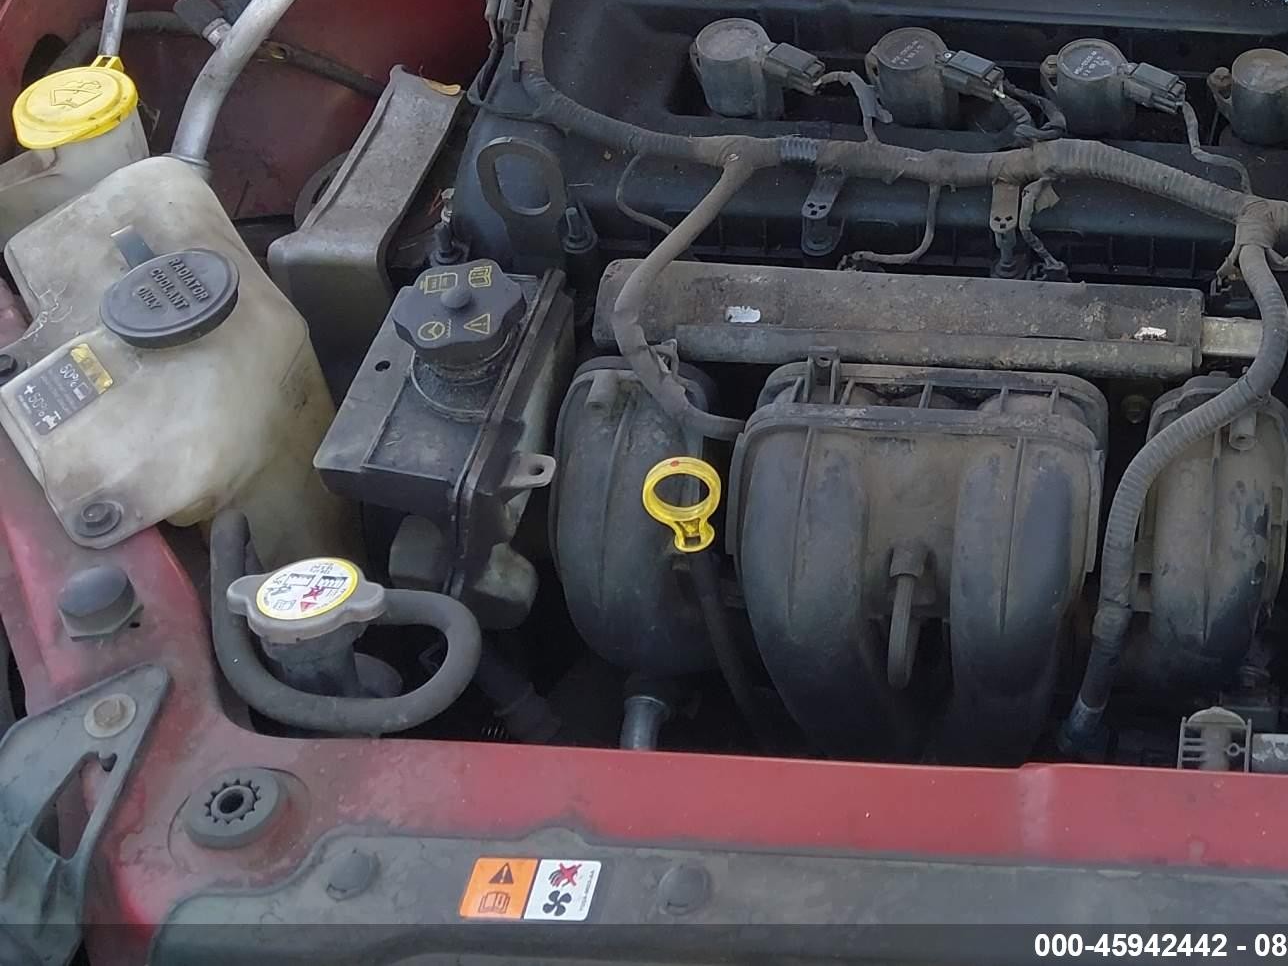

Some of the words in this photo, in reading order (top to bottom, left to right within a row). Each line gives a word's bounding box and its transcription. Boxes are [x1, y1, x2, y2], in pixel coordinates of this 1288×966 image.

[137, 286, 162, 310] ONLY
[151, 267, 190, 310] COOLANT
[168, 257, 209, 302] RADIATOR
